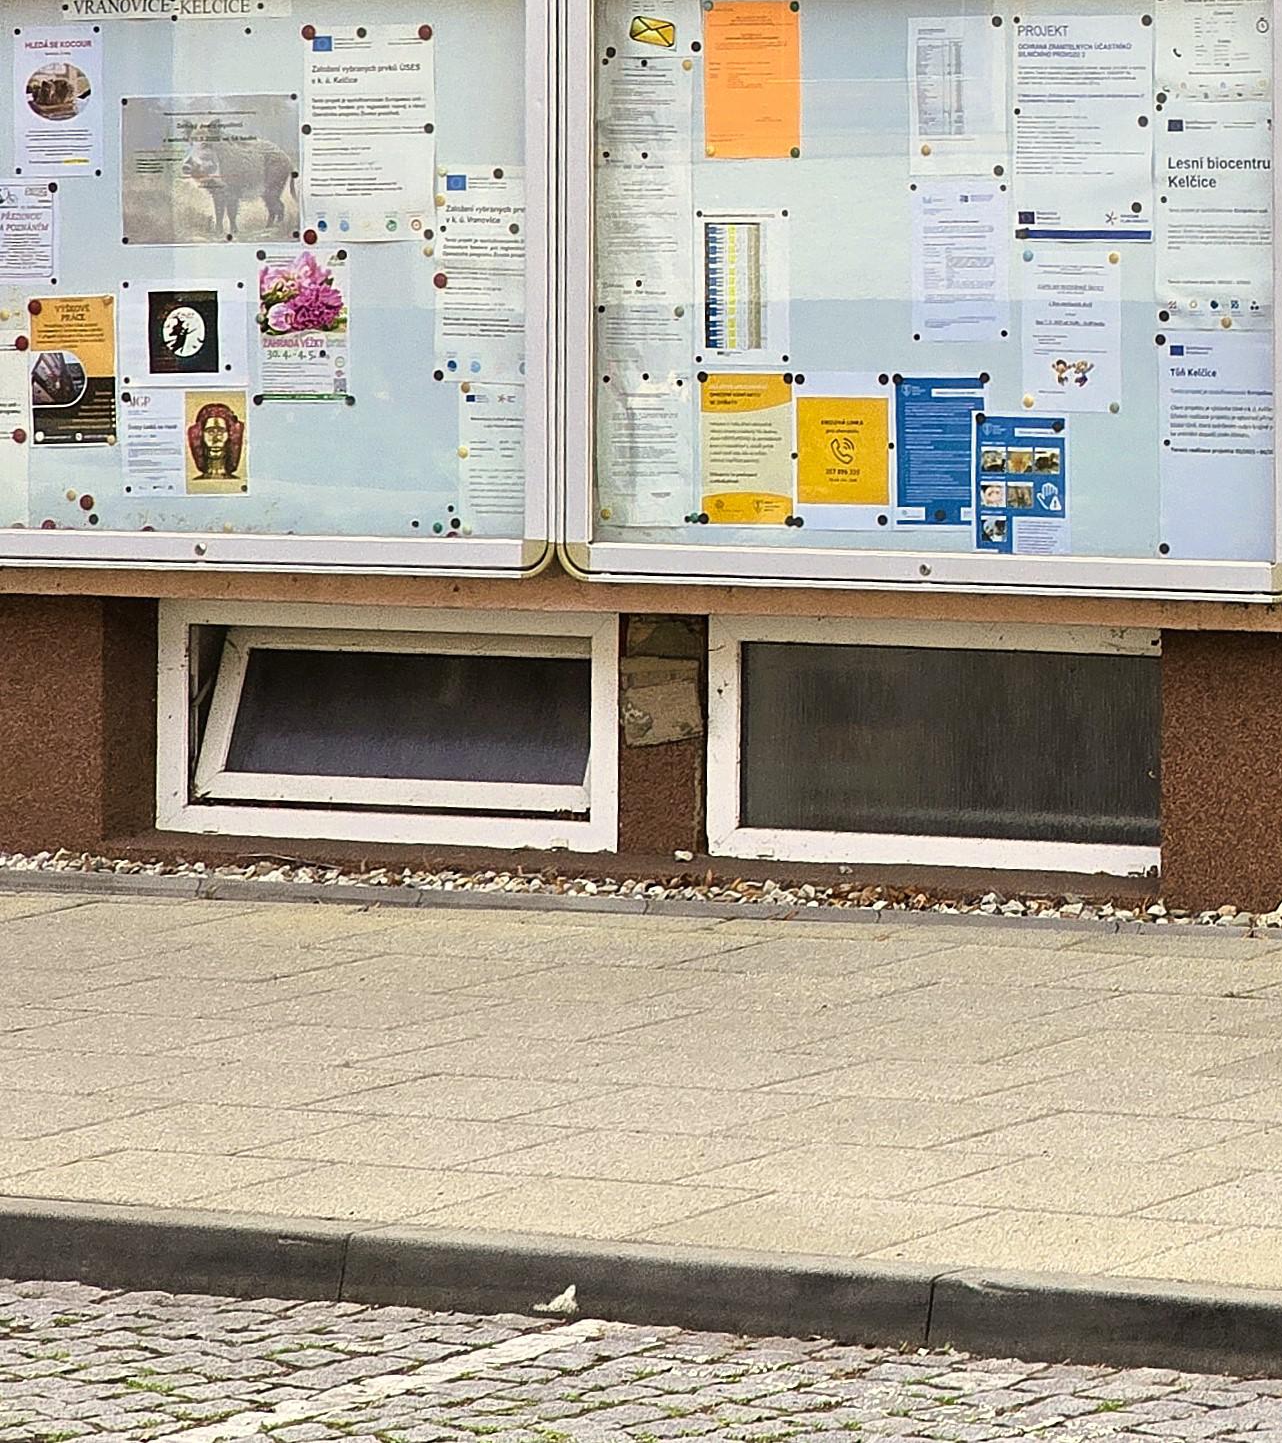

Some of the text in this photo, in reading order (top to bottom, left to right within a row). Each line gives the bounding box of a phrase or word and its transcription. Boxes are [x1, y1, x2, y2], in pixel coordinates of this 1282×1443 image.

[1017, 25, 1068, 36] PROJEKT
[1168, 156, 1271, 169] Lesní biocentru
[1168, 175, 1216, 188] Kelčice
